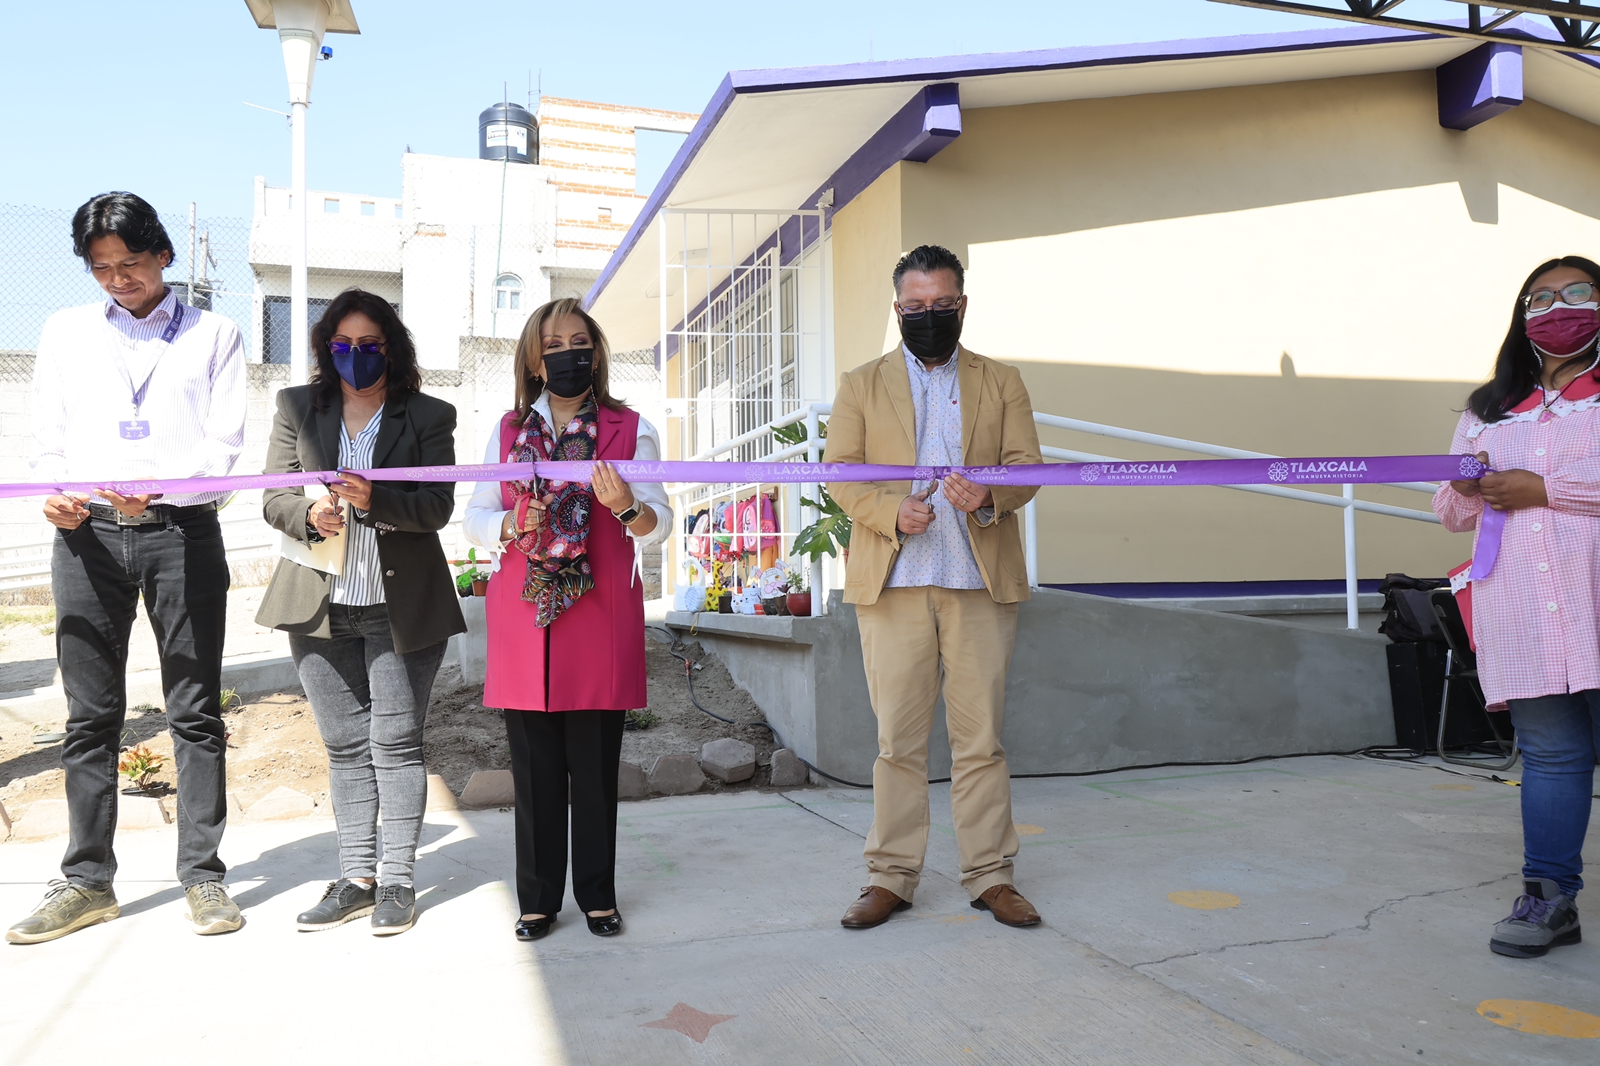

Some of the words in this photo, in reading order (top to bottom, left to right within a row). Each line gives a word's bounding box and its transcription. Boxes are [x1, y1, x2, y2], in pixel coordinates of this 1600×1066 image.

[765, 465, 839, 475] TLAXCALA
[1102, 463, 1178, 474] TLAXCALA
[1290, 461, 1368, 473] TLAXCALA
